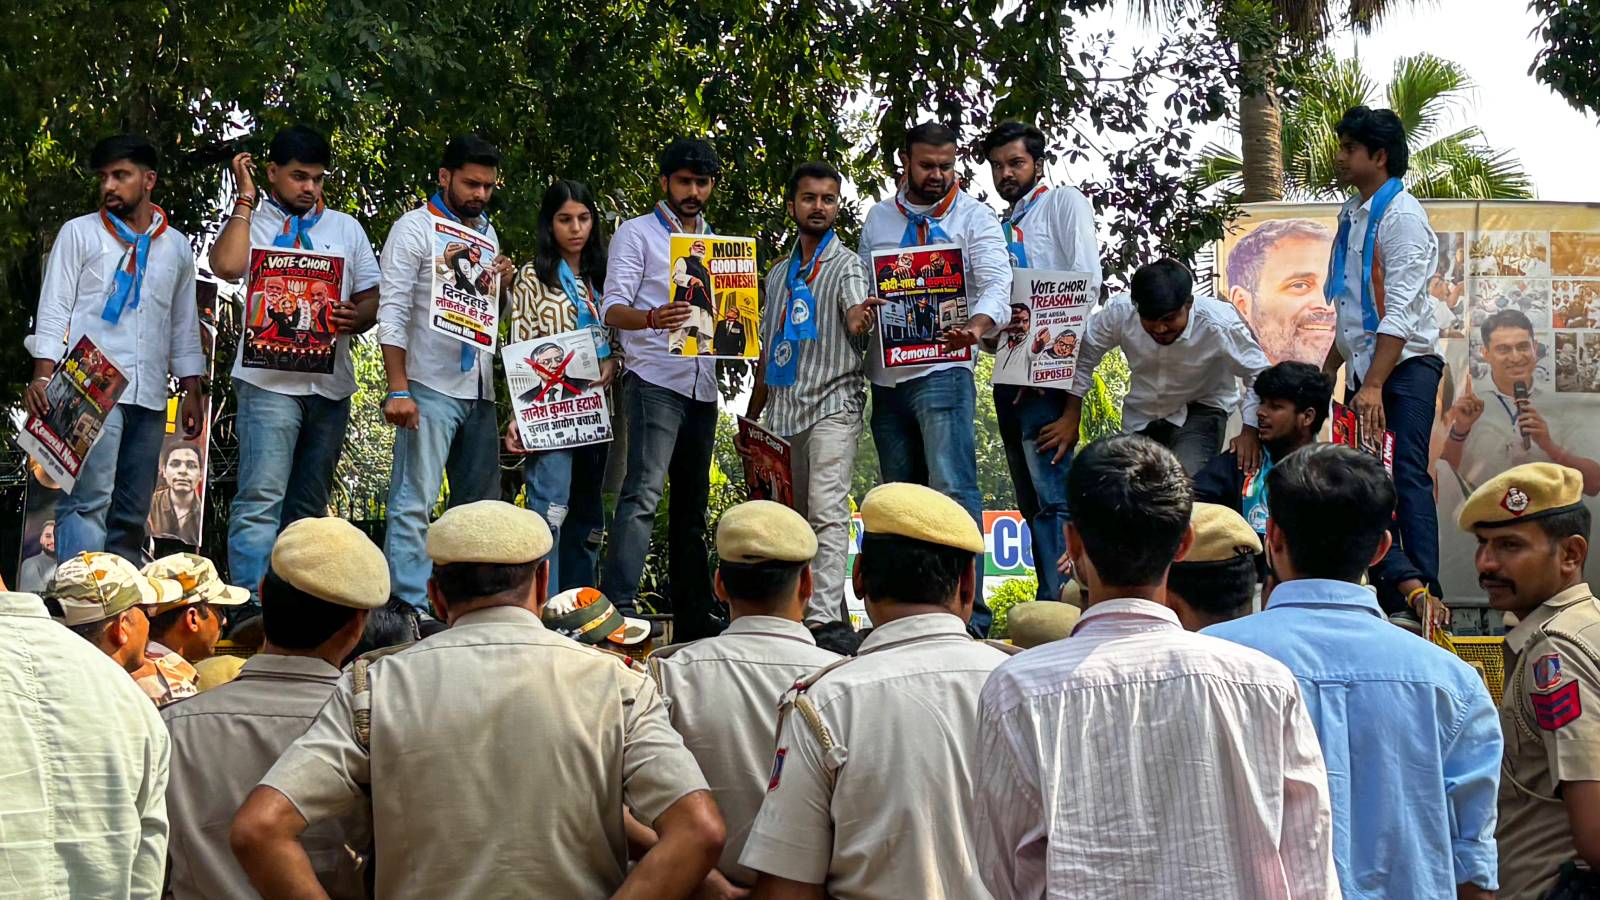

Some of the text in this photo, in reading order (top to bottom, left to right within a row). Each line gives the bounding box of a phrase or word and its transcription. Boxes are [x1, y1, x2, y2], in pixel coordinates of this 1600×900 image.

[712, 242, 753, 258] MODI's
[267, 256, 331, 272] VOTE-CHORI
[711, 259, 755, 273] GOOD BOY
[714, 274, 756, 289] GYANESH!
[1031, 279, 1087, 295] VOTE CHORI
[442, 283, 489, 312] दिनदहाड़े
[1030, 293, 1074, 310] TREASON
[890, 344, 939, 366] Removal
[1035, 368, 1073, 381] EXPOSED
[549, 400, 575, 419] कुमार
[575, 392, 603, 412] हटाओ
[527, 411, 602, 436] चुनाव आयोग बचाओ
[30, 417, 65, 453] Removal
